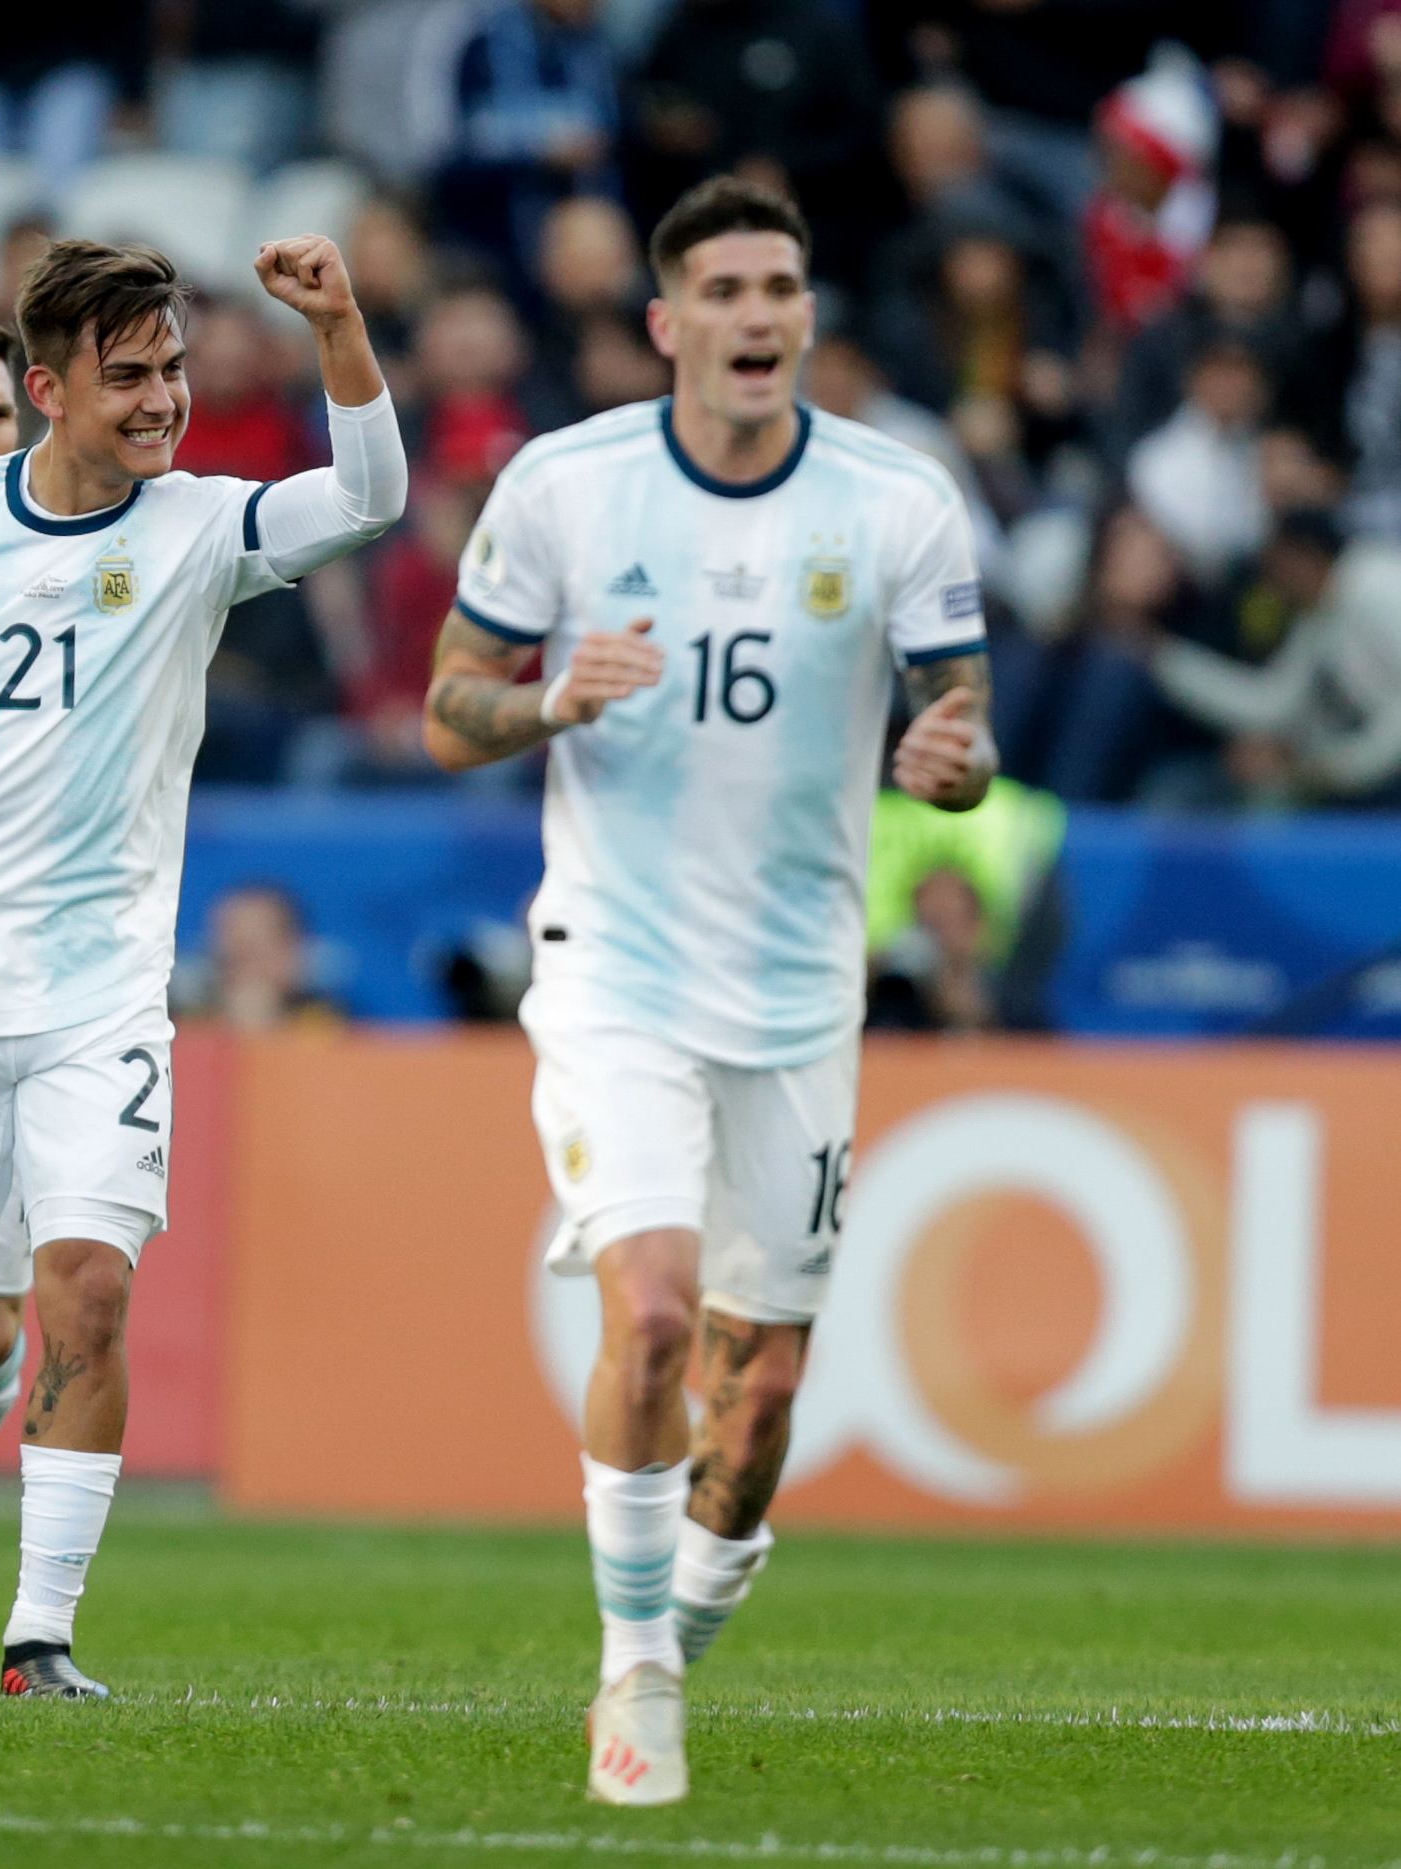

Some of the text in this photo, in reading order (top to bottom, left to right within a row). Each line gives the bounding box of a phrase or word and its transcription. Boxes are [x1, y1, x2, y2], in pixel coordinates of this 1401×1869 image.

[104, 573, 130, 598] AFA
[688, 629, 775, 724] 16
[118, 1048, 174, 1136] 2
[136, 1159, 165, 1179] adida
